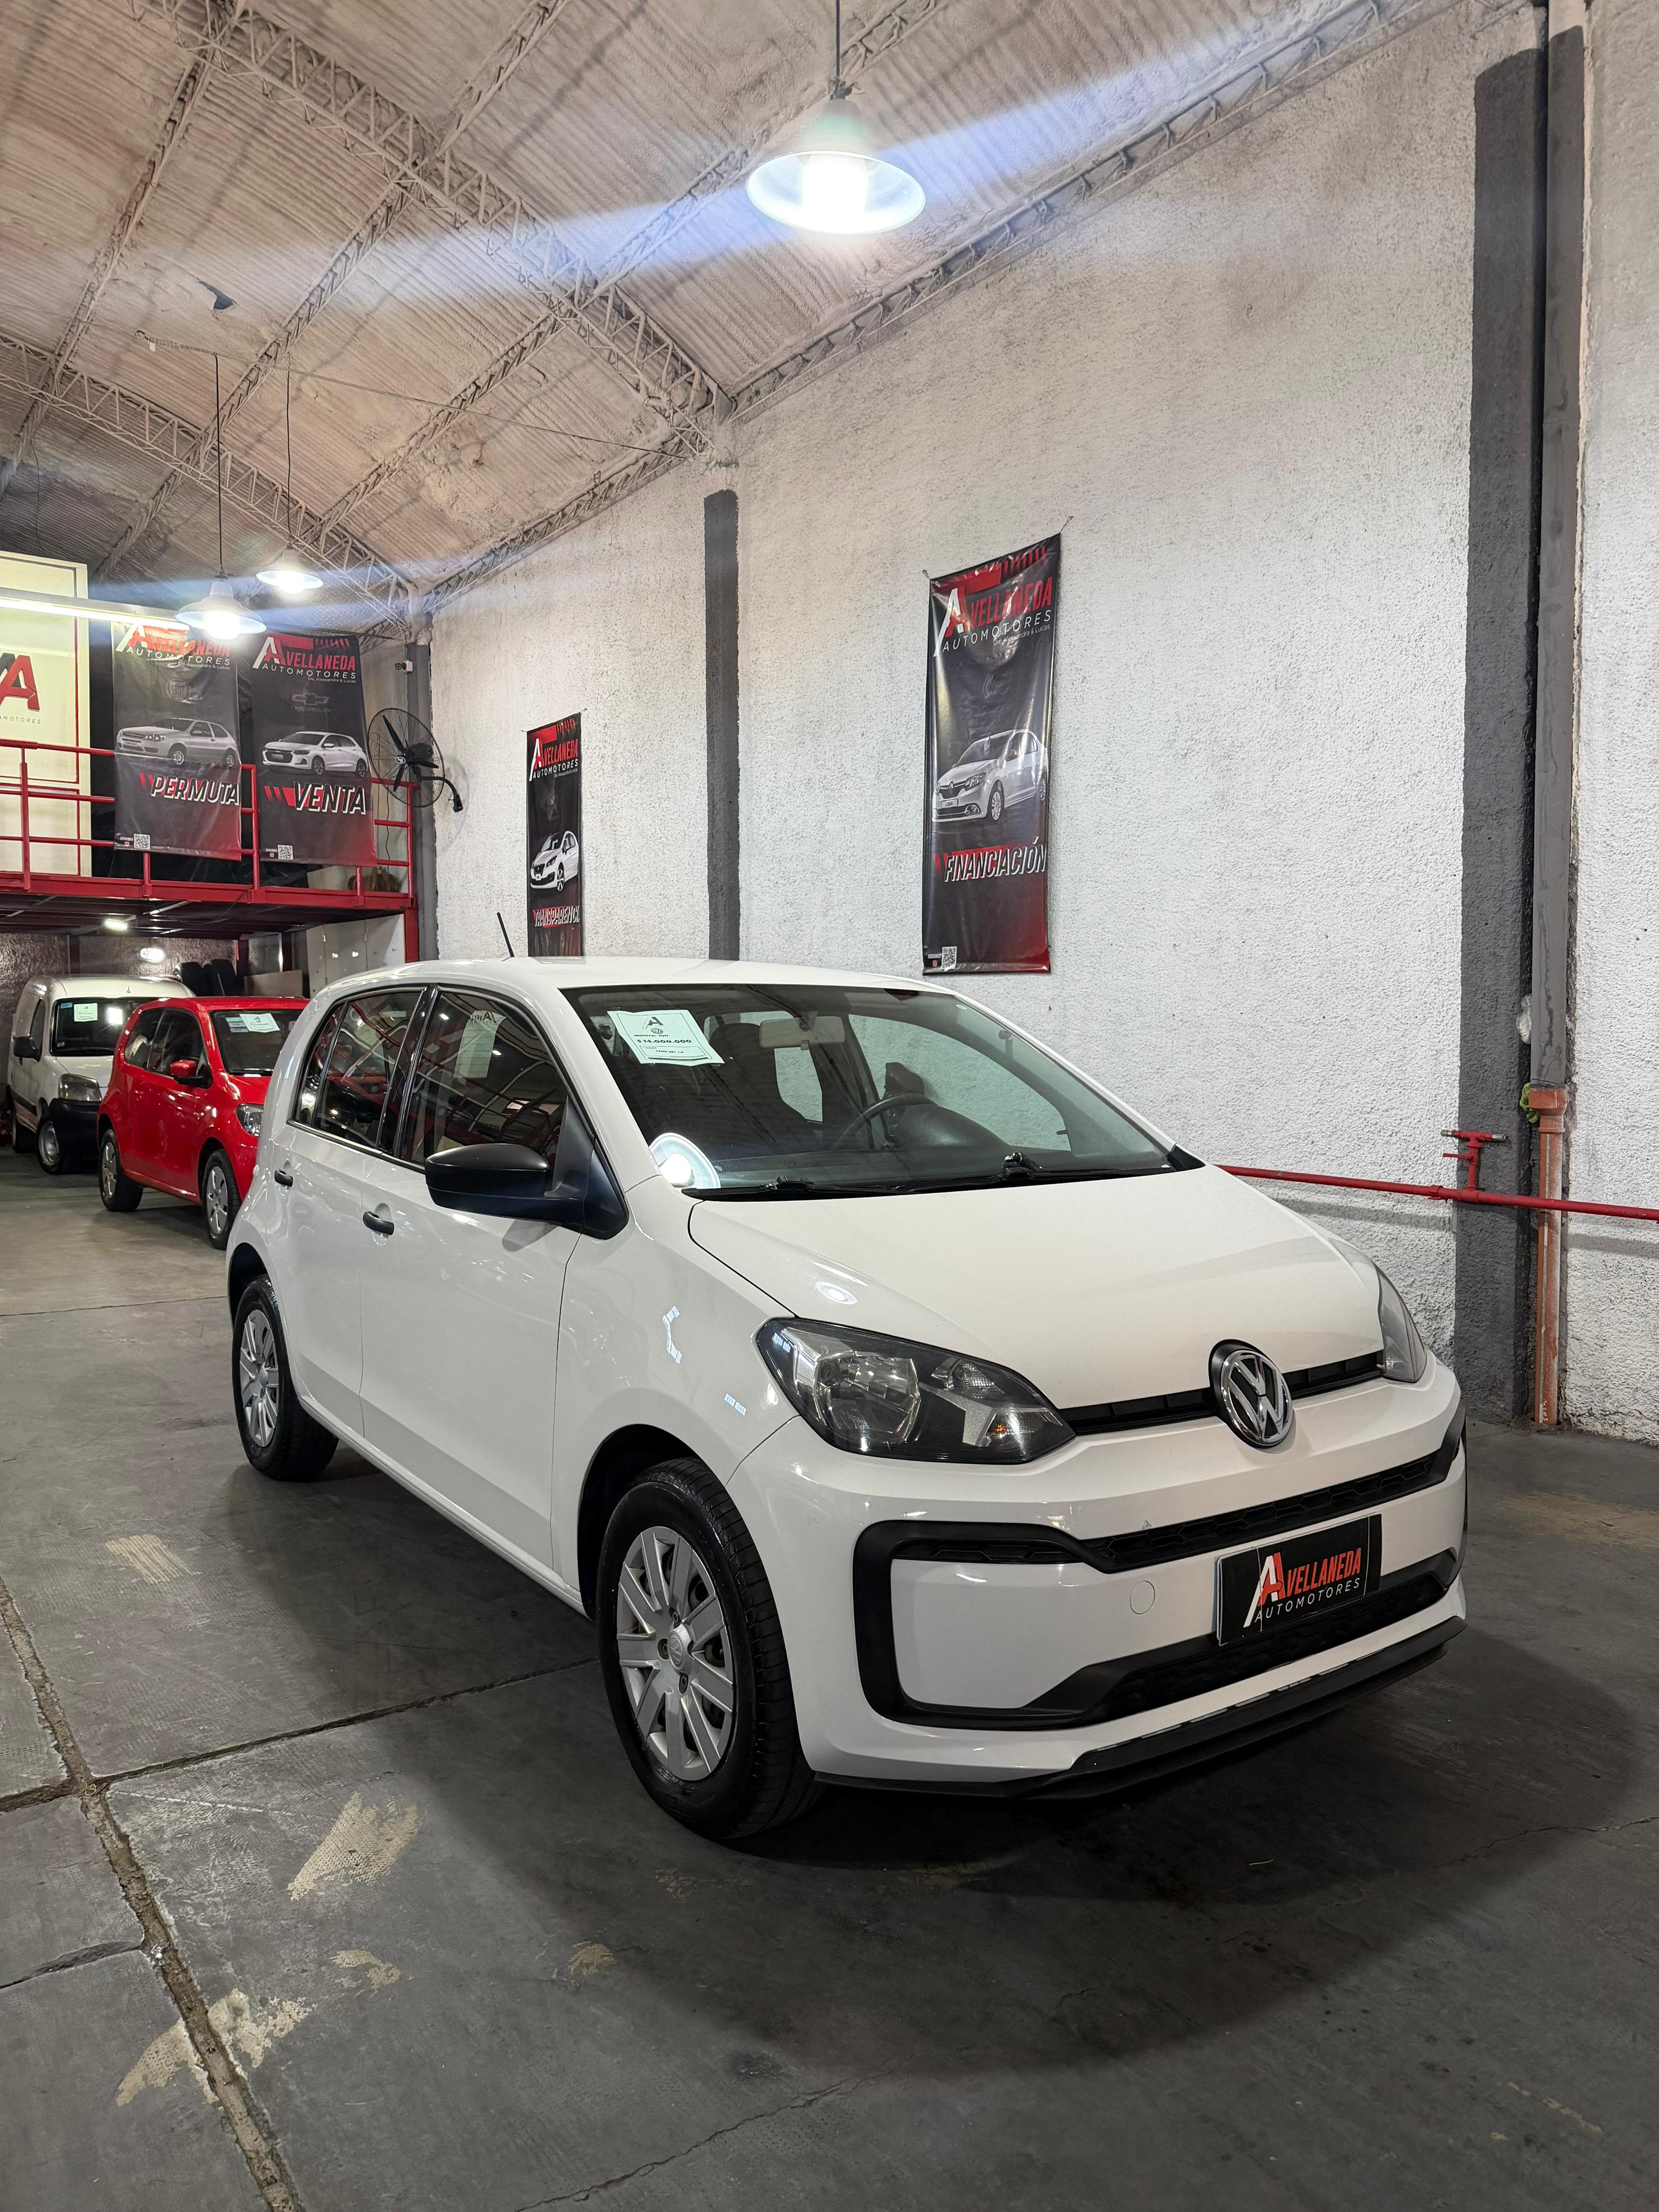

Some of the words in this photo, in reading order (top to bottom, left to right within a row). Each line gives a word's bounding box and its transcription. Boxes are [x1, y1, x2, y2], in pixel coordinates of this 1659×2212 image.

[933, 577, 1052, 657] AVELLANEDA
[942, 609, 1052, 653] AUTOMOTORES
[1035, 624, 1050, 633] Lucas
[127, 646, 230, 666] AUTOMOTORES
[252, 636, 356, 672] AVELLANEDA
[262, 663, 356, 680] AUTOMOTORES
[529, 738, 578, 782] AVELLANEDA
[533, 759, 579, 779] AUTOMOTORES
[150, 774, 239, 806] PERMUTA
[294, 782, 366, 815] VENTA
[944, 836, 1046, 883] FINANCIACIÓN
[1243, 1548, 1361, 1628] AVELLANEDA
[1255, 1577, 1360, 1623] AUTOMOTORES
